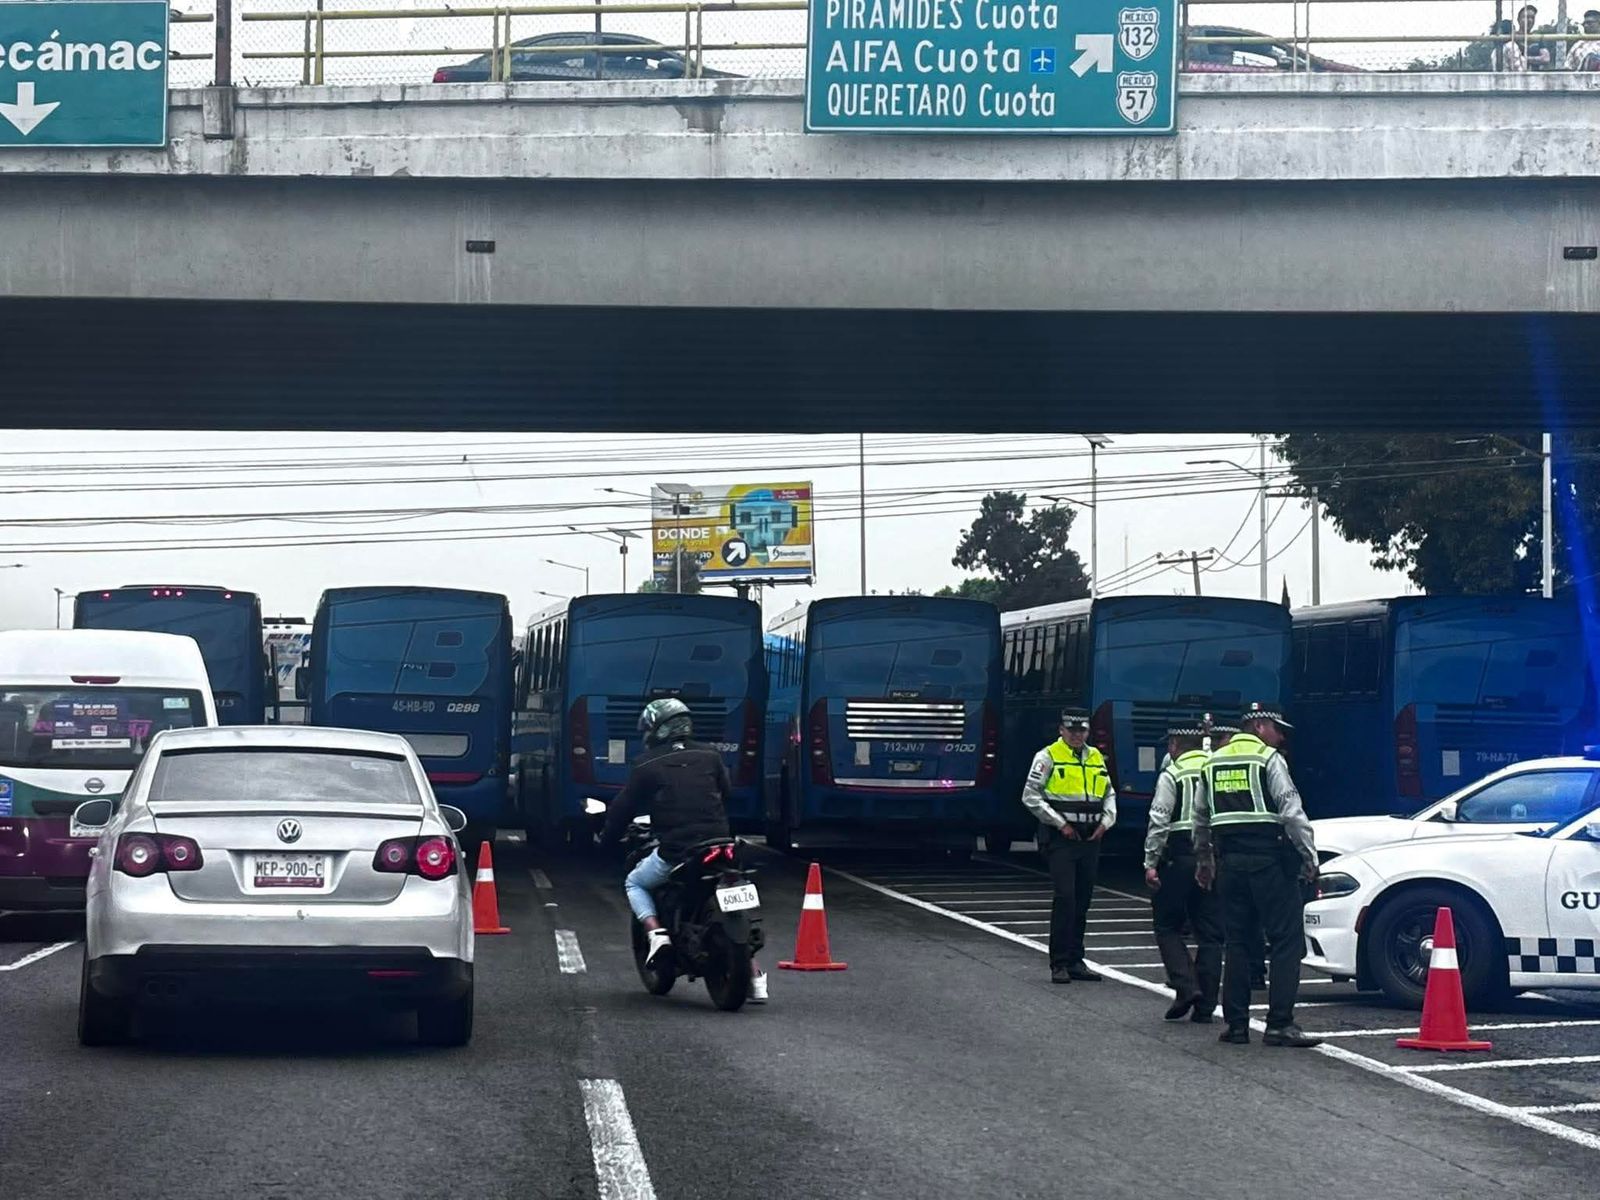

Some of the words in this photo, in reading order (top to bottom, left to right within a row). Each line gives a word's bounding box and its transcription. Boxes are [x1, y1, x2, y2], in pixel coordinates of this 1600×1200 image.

[976, 0, 1058, 29] Cuota
[1124, 26, 1153, 46] 132
[0, 29, 162, 71] cámac
[825, 40, 904, 73] AIFA
[914, 40, 1020, 73] Cuota
[828, 83, 967, 117] QUERETARO
[979, 83, 1056, 117] Cuota
[1125, 89, 1148, 110] 57
[657, 528, 710, 540] DONDE
[255, 861, 323, 877] MEP-900-C
[1560, 890, 1600, 910] GU
